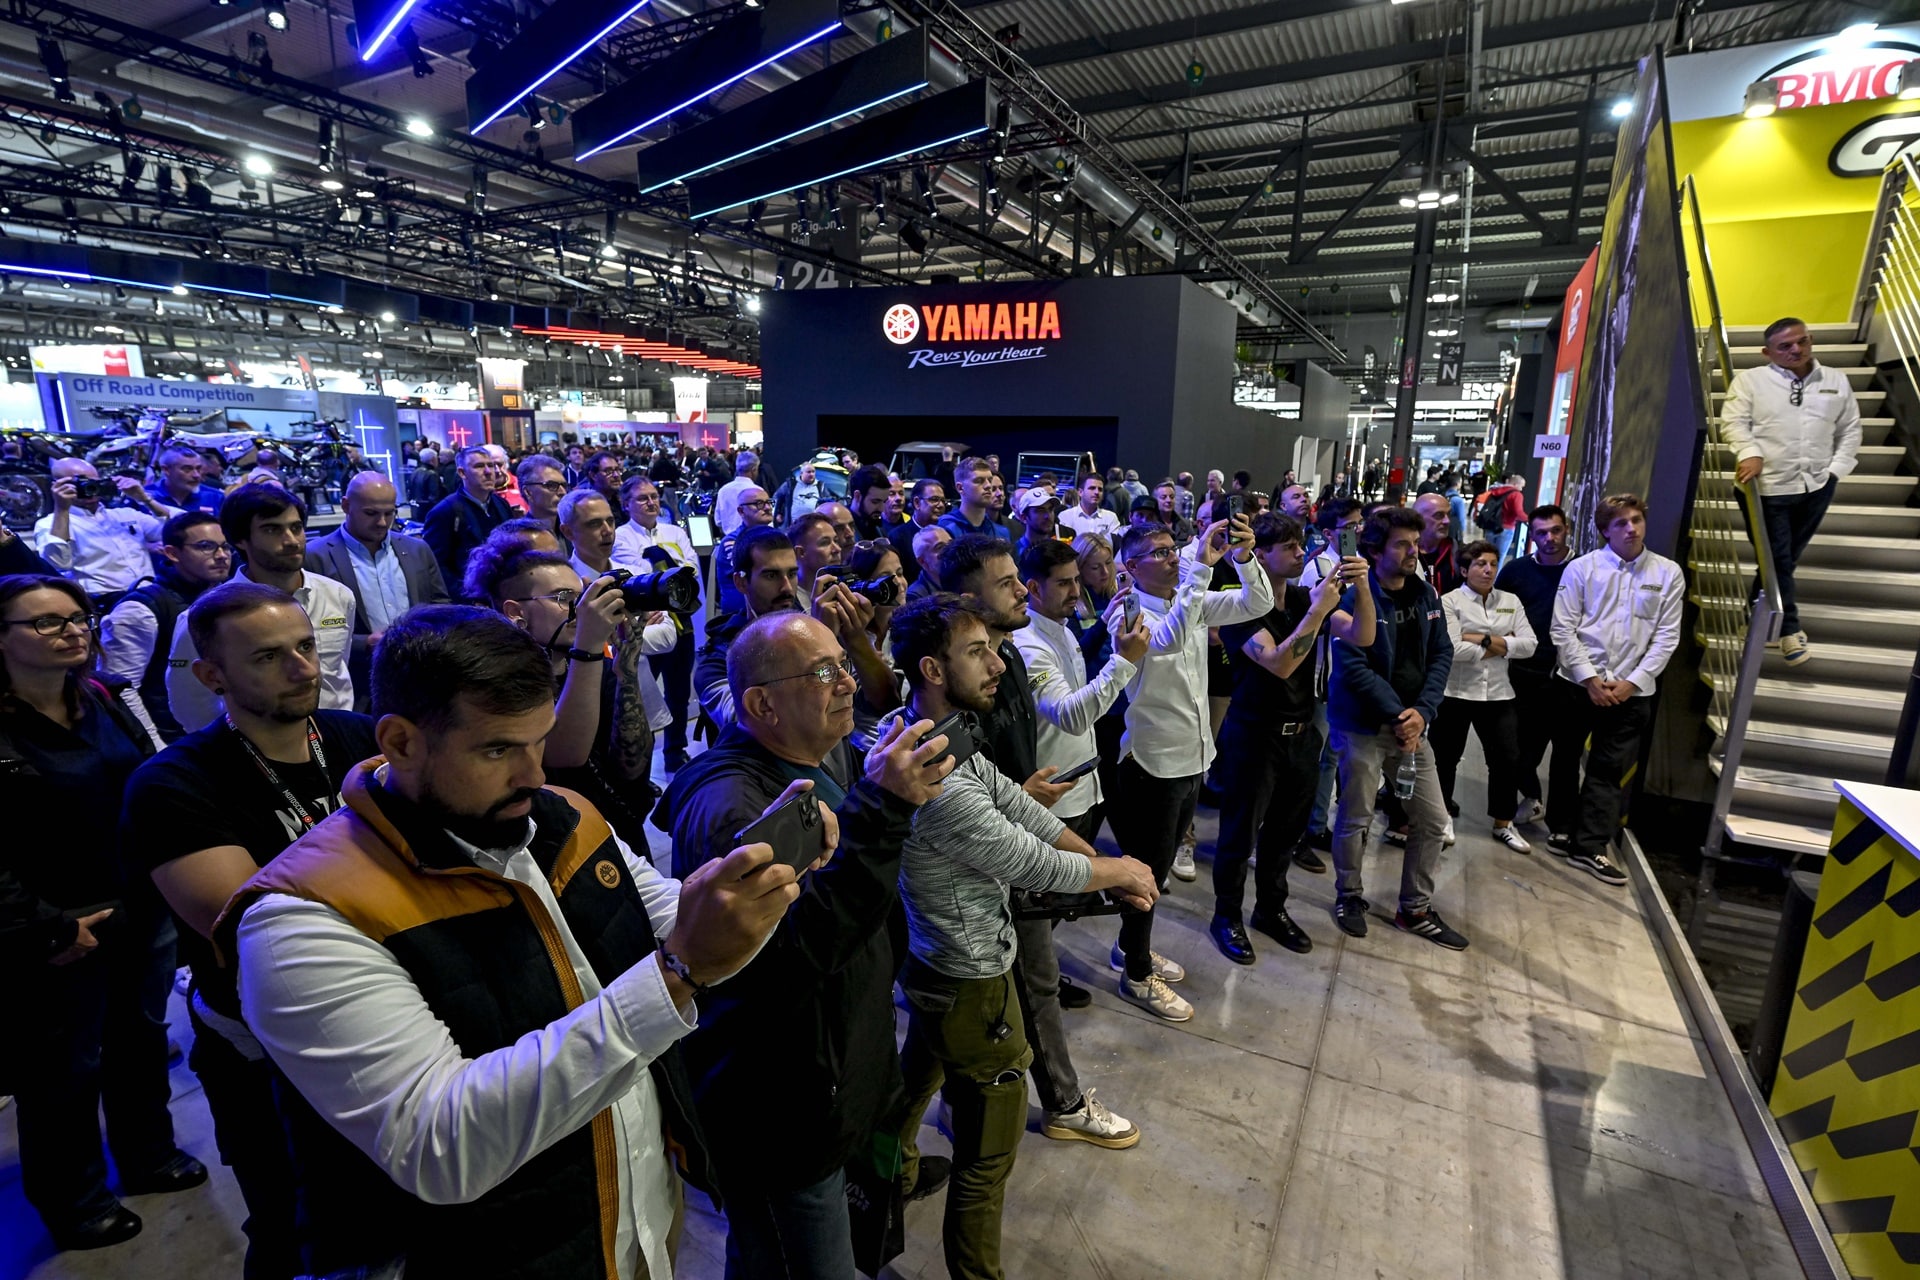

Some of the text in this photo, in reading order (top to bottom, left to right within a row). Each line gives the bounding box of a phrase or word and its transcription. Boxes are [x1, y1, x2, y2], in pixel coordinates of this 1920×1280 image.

[792, 260, 839, 289] 24
[922, 302, 1061, 341] YAMAHA
[908, 346, 1045, 369] Revs Your Heart
[1448, 346, 1461, 355] 24
[1442, 363, 1458, 380] N
[73, 377, 254, 403] Off Road Competition
[1540, 441, 1562, 451] N60
